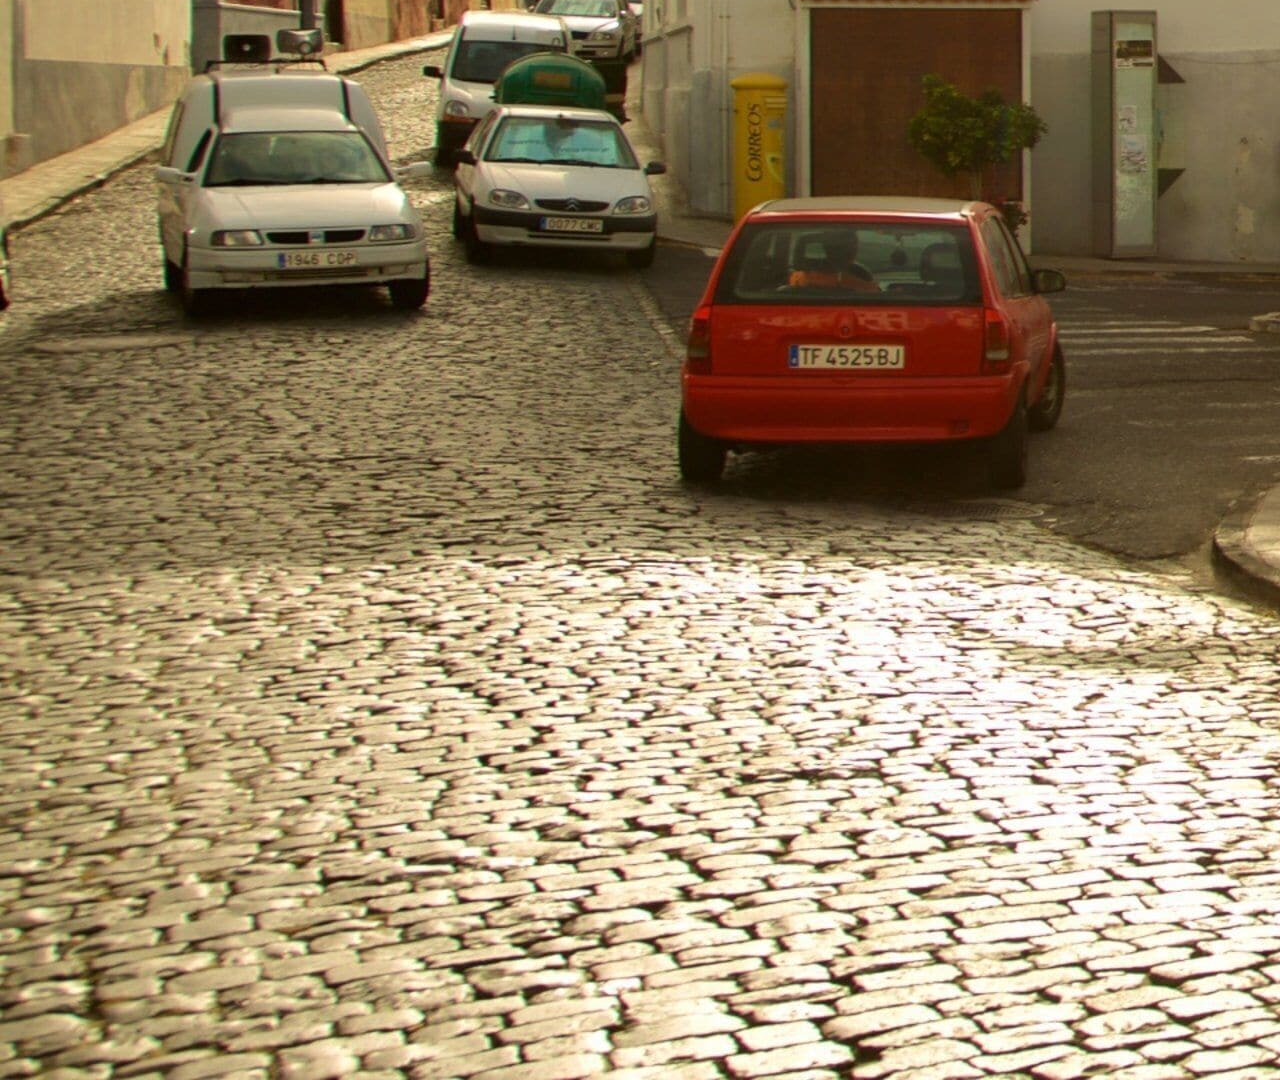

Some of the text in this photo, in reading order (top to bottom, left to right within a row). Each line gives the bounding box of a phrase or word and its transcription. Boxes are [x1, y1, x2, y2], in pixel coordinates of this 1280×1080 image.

[744, 103, 763, 182] CORREOS
[799, 347, 900, 366] TF 4525 BJ
